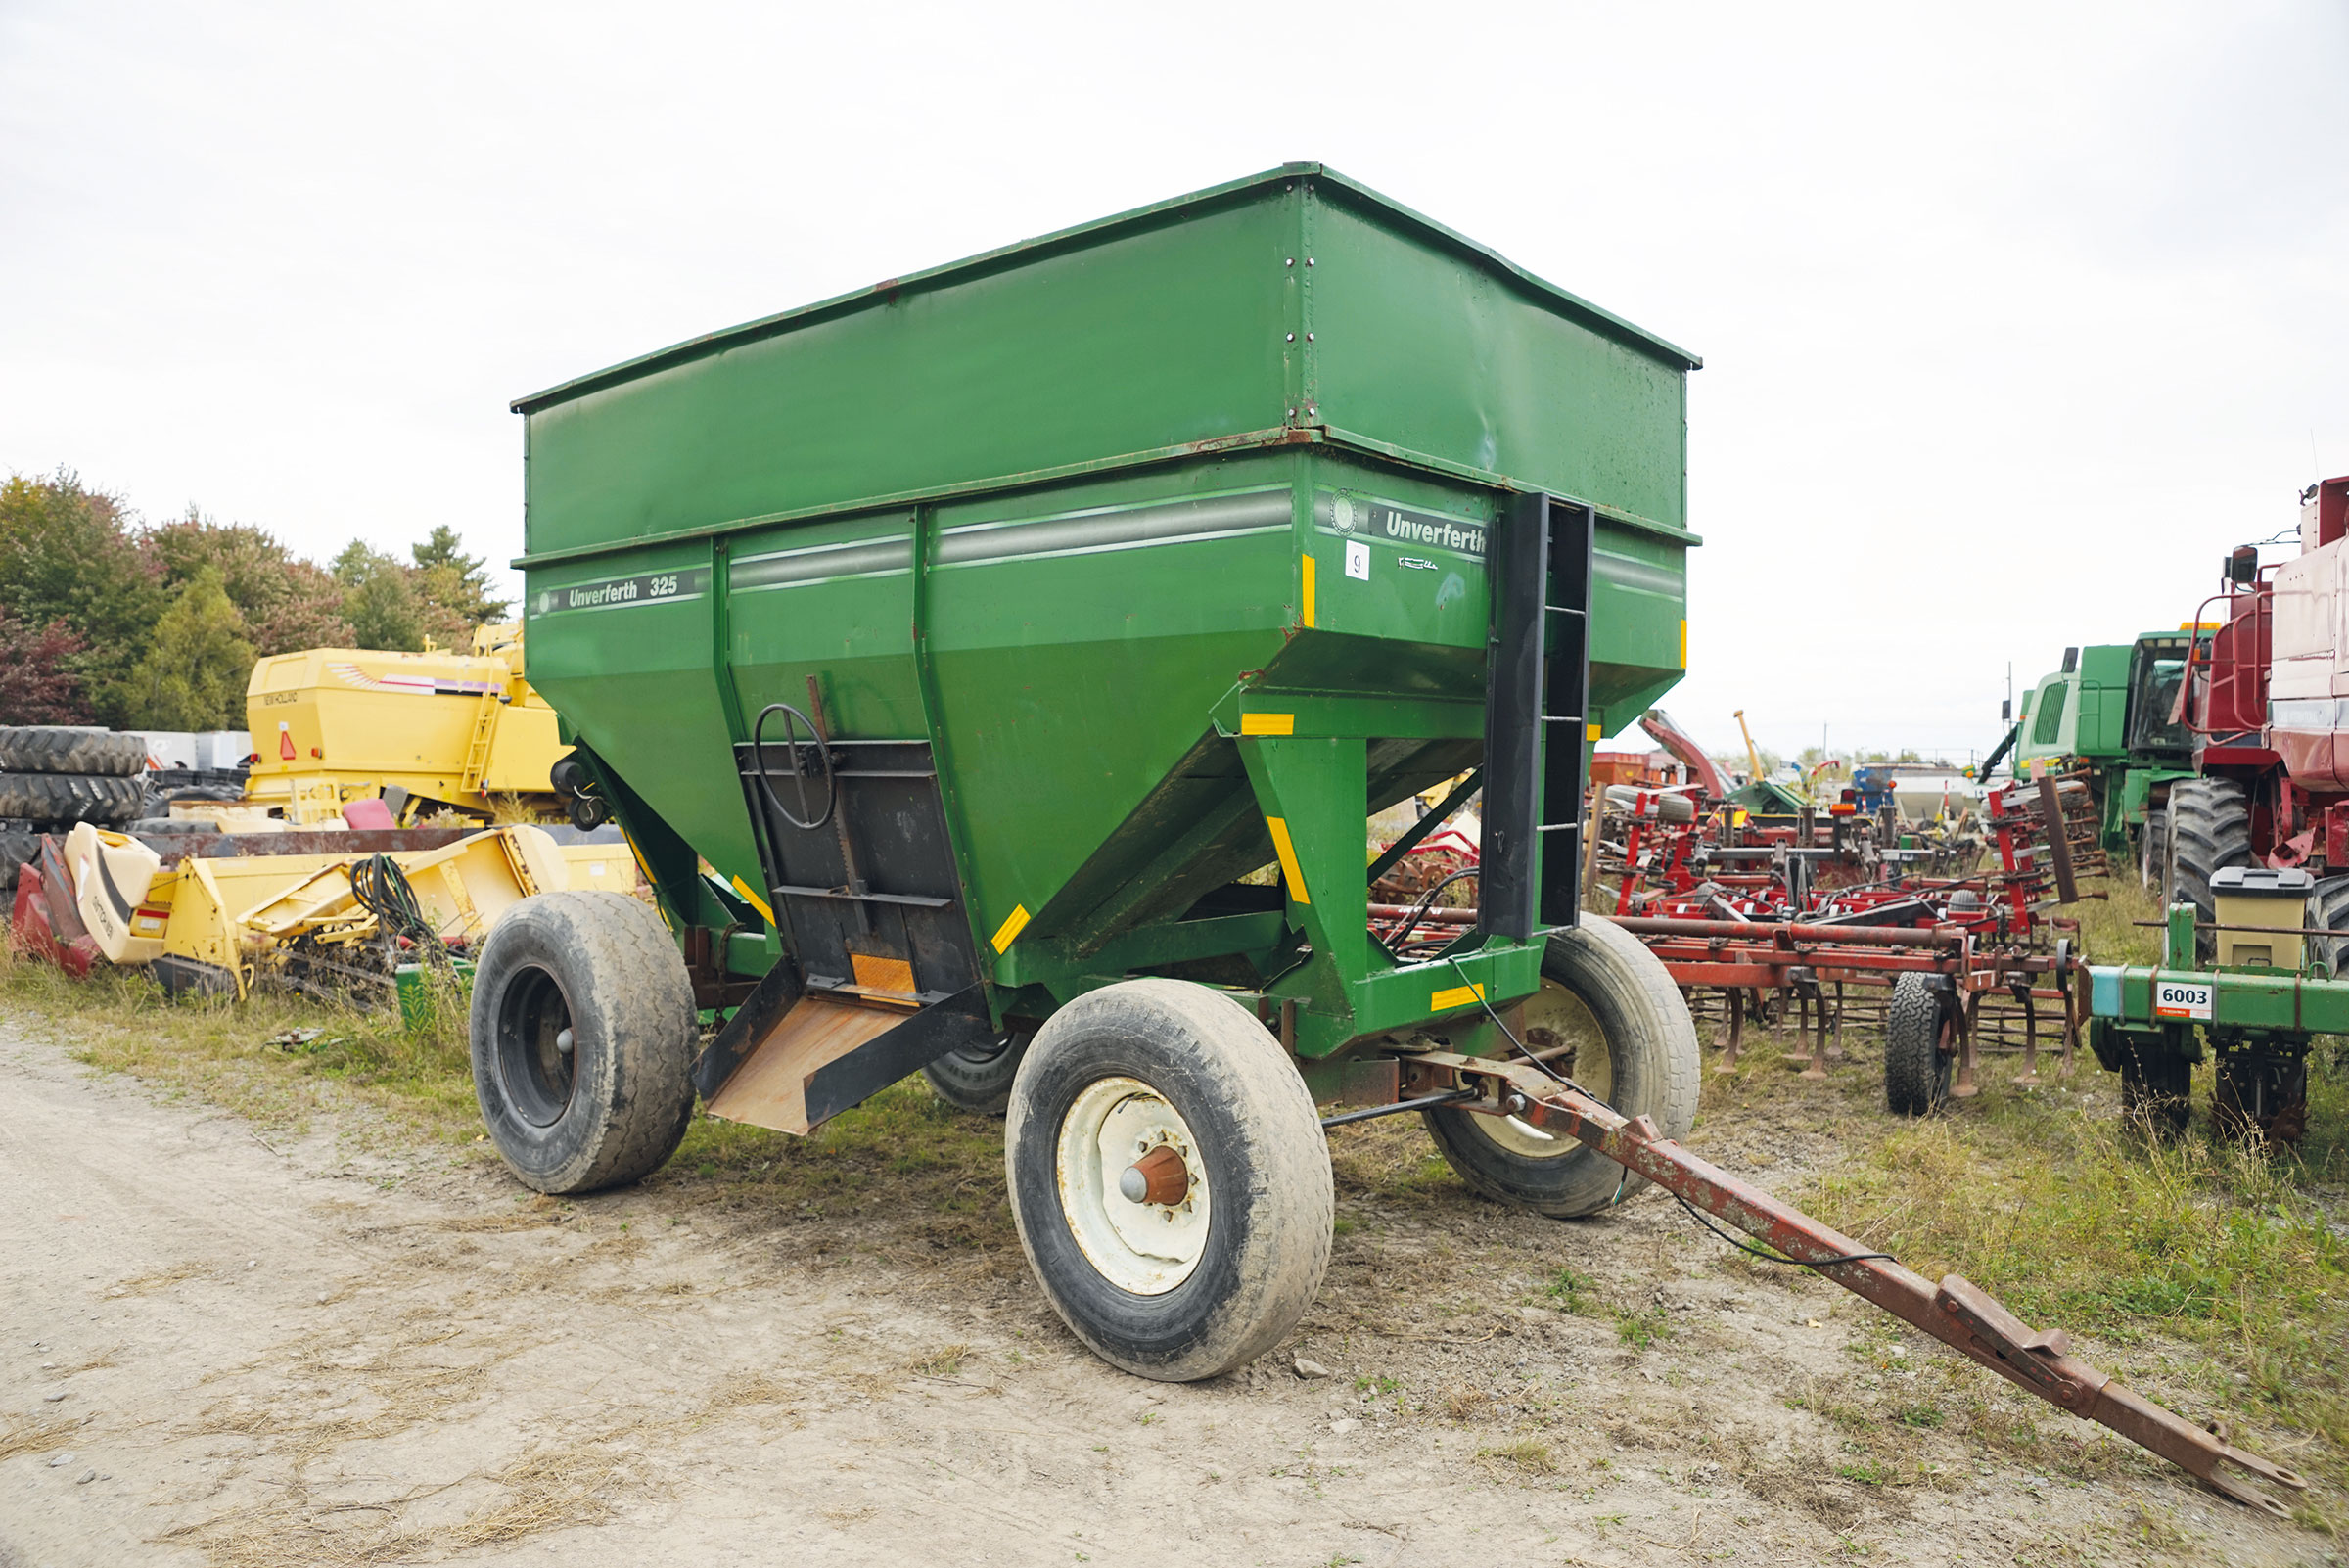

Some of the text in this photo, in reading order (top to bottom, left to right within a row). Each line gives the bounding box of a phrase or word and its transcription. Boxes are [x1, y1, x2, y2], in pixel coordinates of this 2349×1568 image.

[1386, 511, 1487, 553] Unverferth
[1353, 554, 1361, 574] 9
[569, 575, 678, 607] Unverferth 325
[2162, 988, 2208, 1005] 6003
